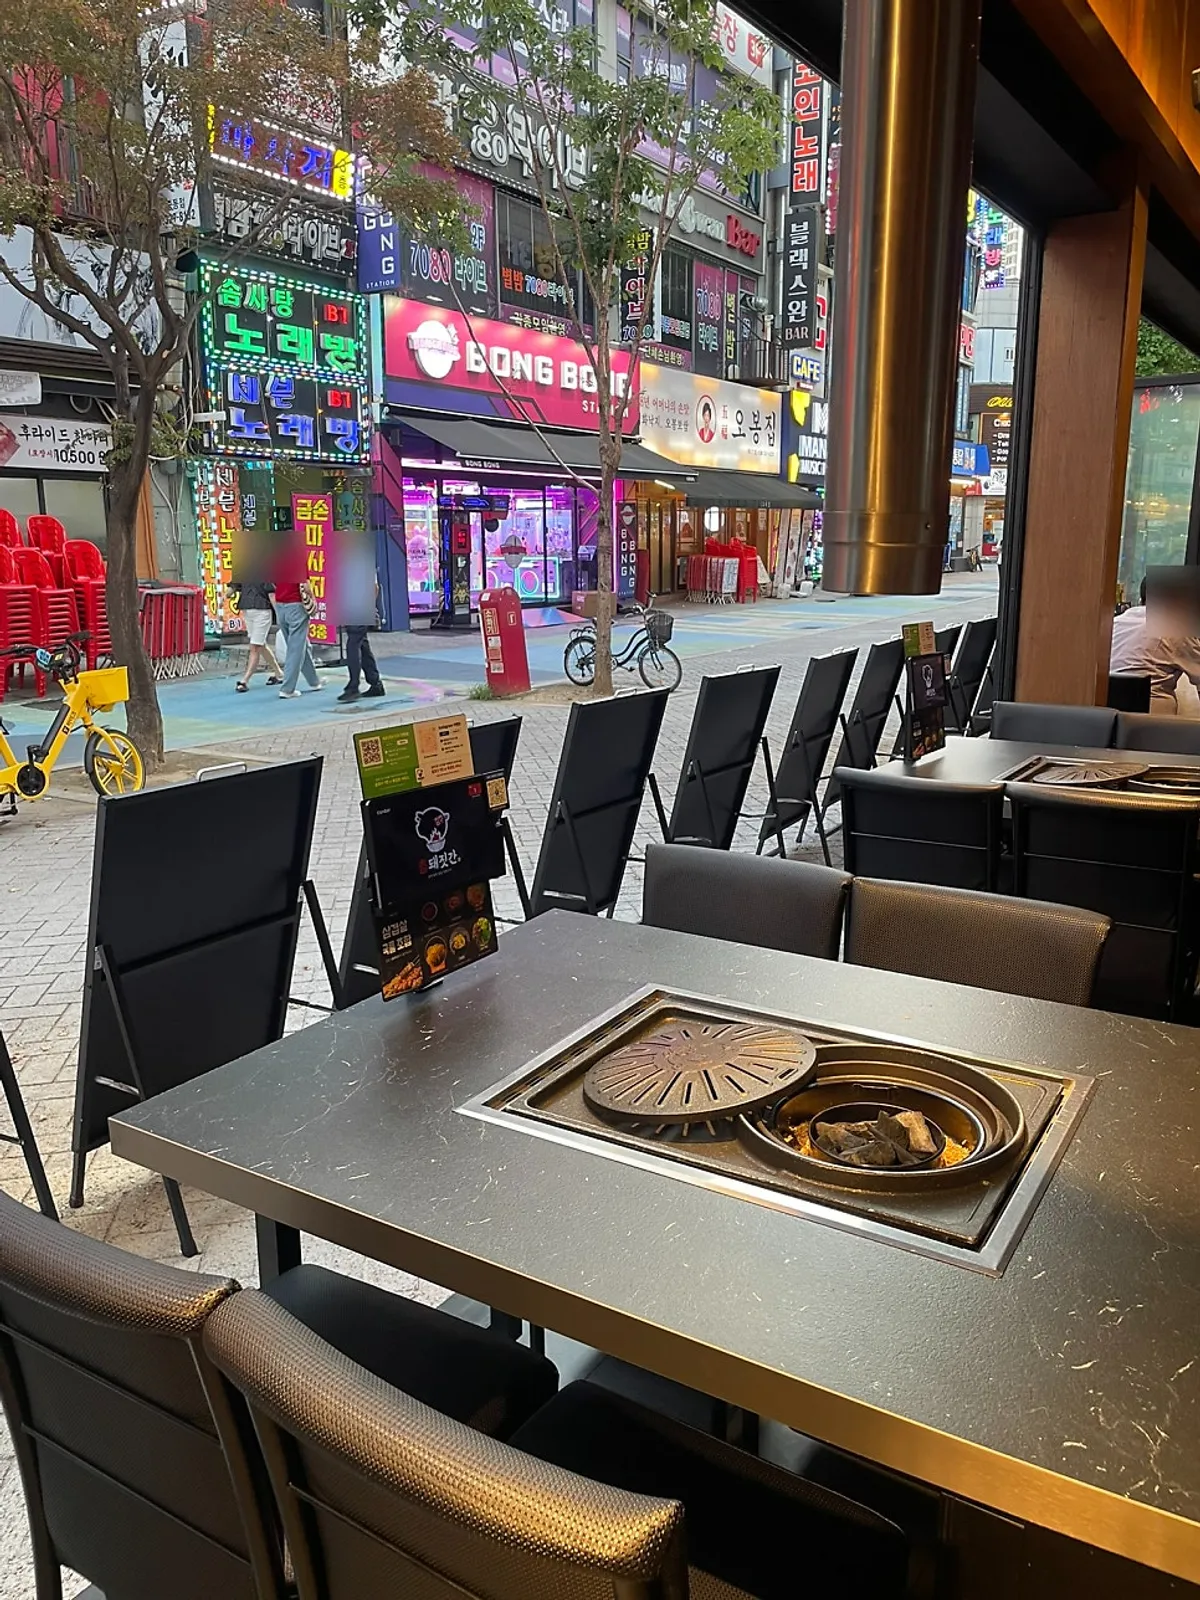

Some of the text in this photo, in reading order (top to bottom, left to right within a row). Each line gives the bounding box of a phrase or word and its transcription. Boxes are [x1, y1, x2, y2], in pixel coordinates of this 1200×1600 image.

[506, 104, 588, 191] 라이브
[283, 211, 341, 262] 라이브
[726, 214, 760, 257] Bar
[985, 207, 1003, 267] 노래방
[366, 279, 395, 289] STATION
[410, 239, 488, 294] 7080 라이브
[502, 266, 524, 293] 별밤
[788, 220, 810, 323] 블랙스완
[216, 279, 348, 324] 솜사탕 B1
[785, 326, 809, 341] BAR
[466, 341, 553, 387] BONG
[793, 355, 820, 381] CAFE
[328, 390, 352, 409] B1
[19, 423, 71, 444] 후라이드
[228, 406, 362, 454] 노래방
[731, 408, 776, 448] 오봉집
[465, 459, 500, 470] BONG BONG
[304, 524, 327, 599] 마사지
[620, 527, 628, 577] BONG
[628, 540, 636, 588] BONG
[229, 619, 243, 630] B1
